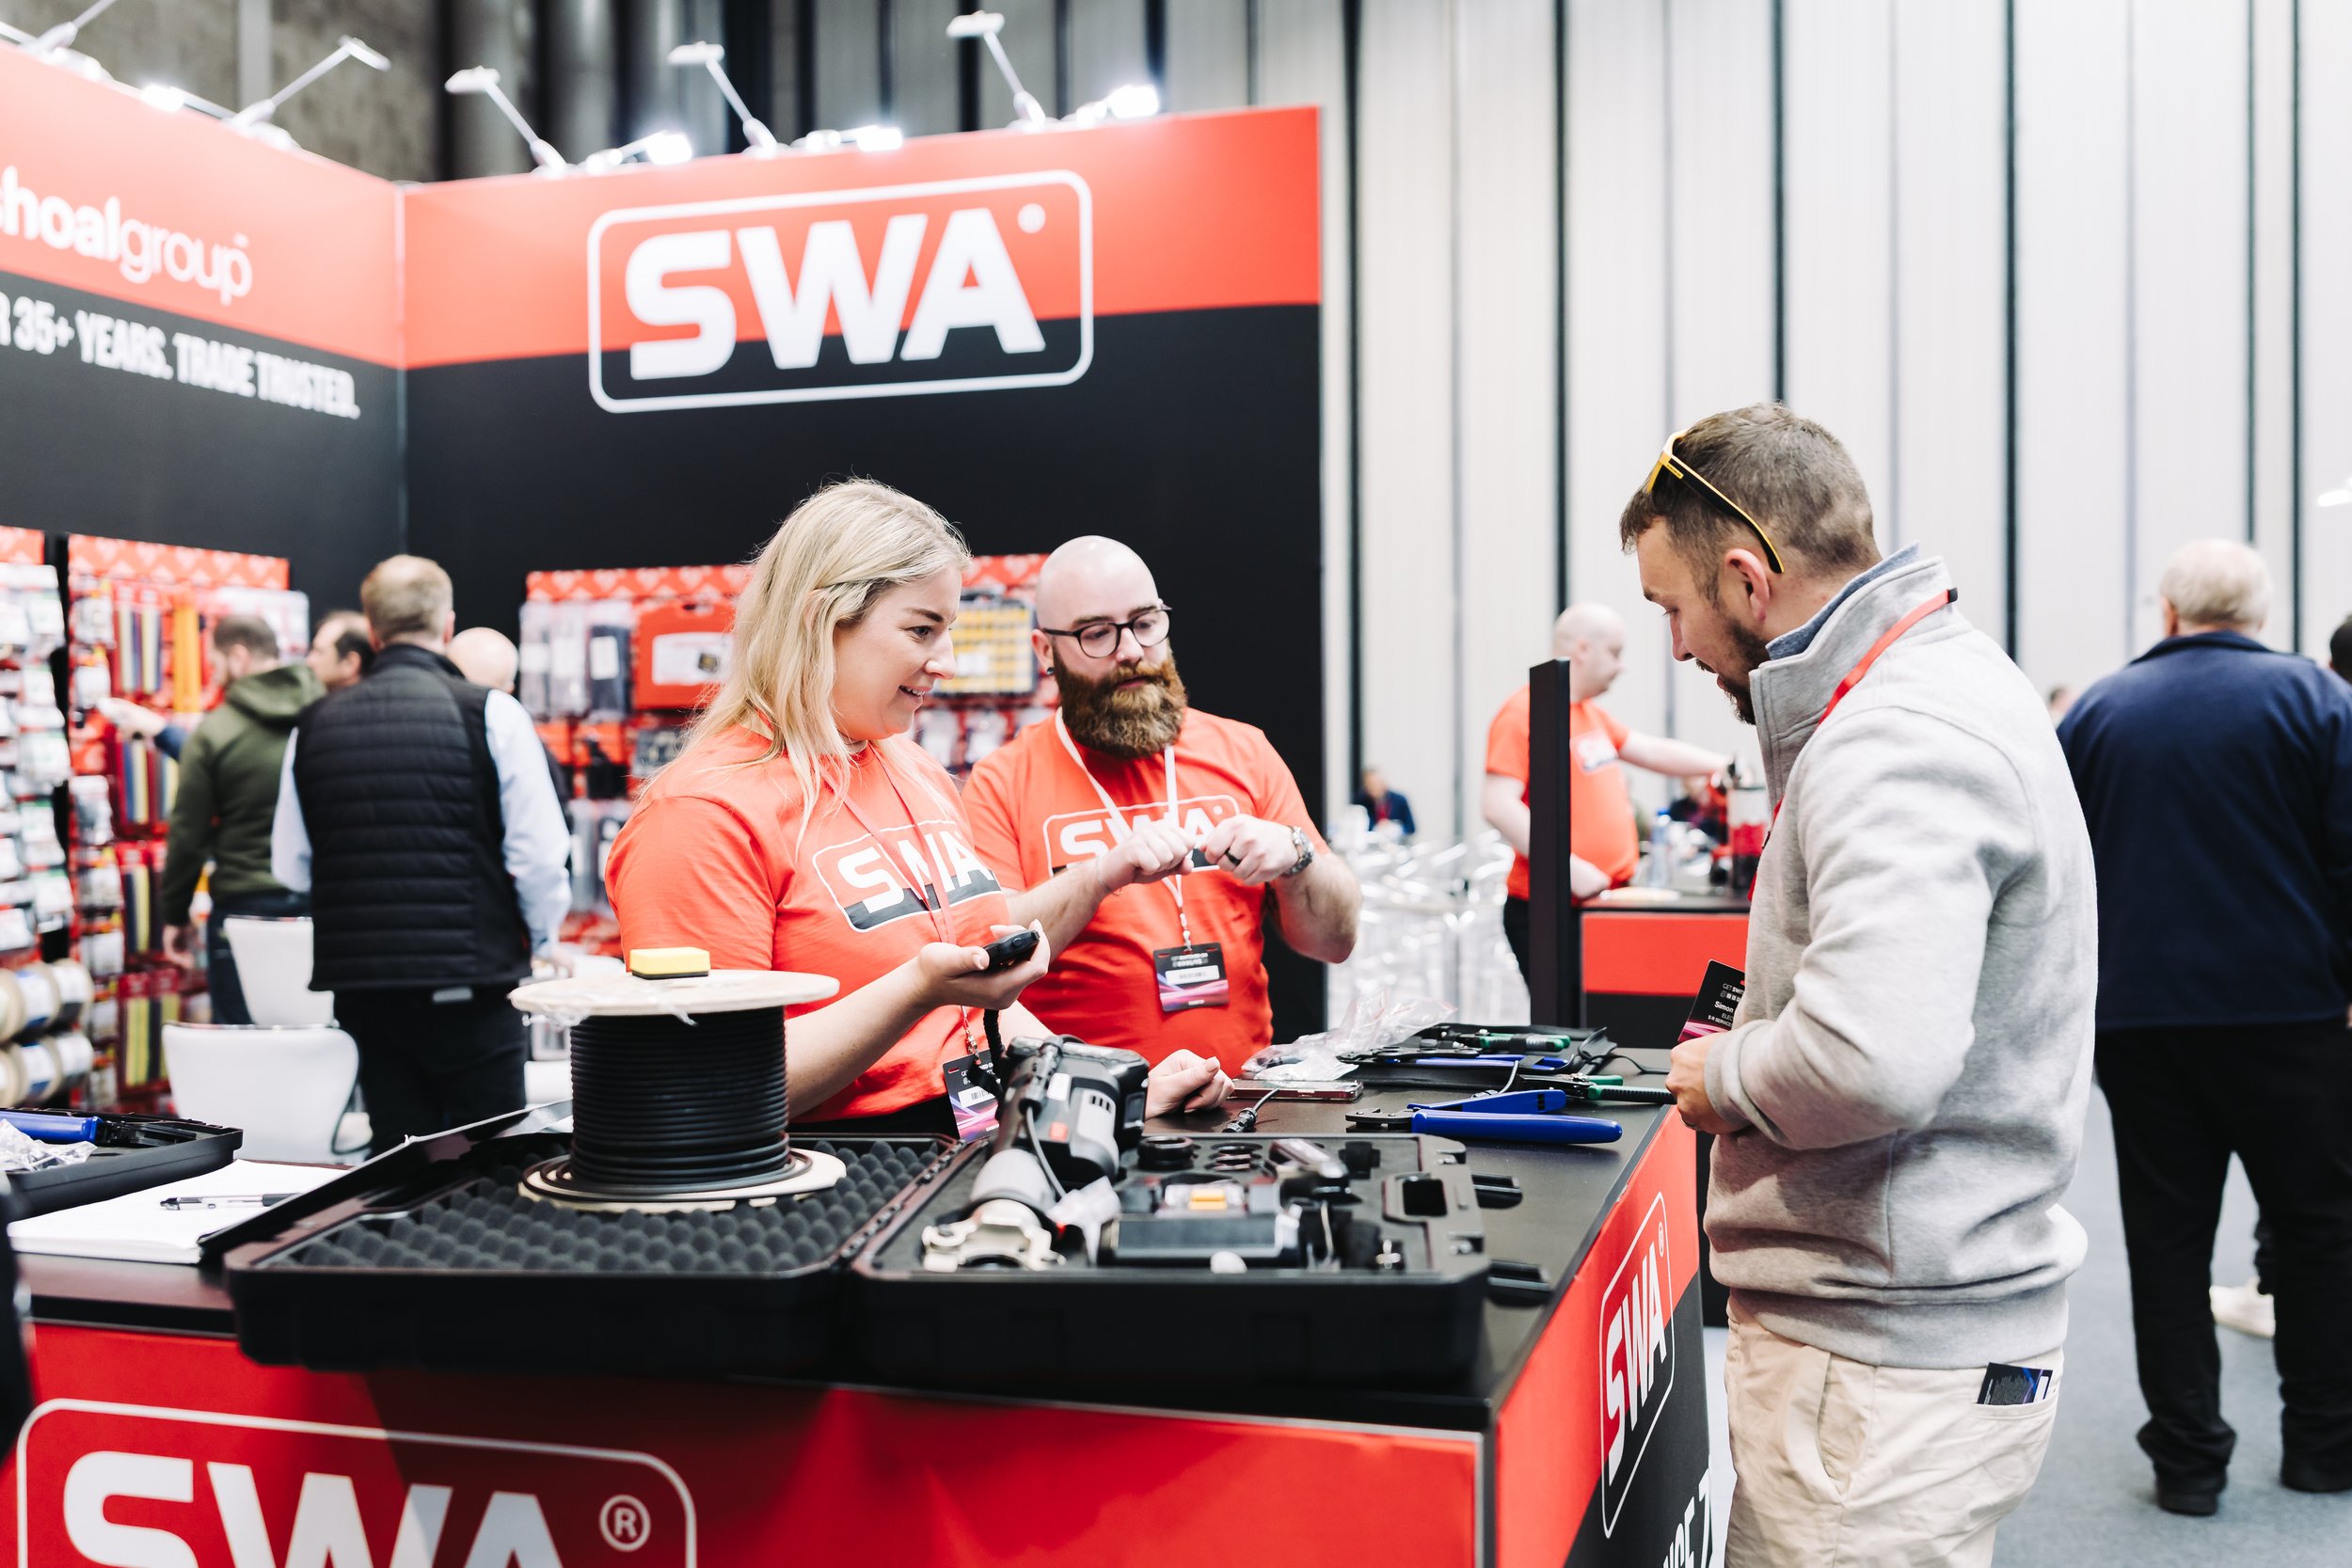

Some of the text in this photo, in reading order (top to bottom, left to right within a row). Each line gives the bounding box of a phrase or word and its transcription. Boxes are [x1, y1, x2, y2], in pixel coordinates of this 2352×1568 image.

[0, 166, 253, 306] hoalgroup
[625, 207, 1046, 380] SWA
[13, 295, 75, 355] 35+
[75, 309, 174, 379] YEARS.
[172, 332, 257, 397] TRADE
[254, 351, 361, 420] TRUSTED.
[1714, 1000, 1734, 1013] Simon
[1606, 1242, 1667, 1486] SWA
